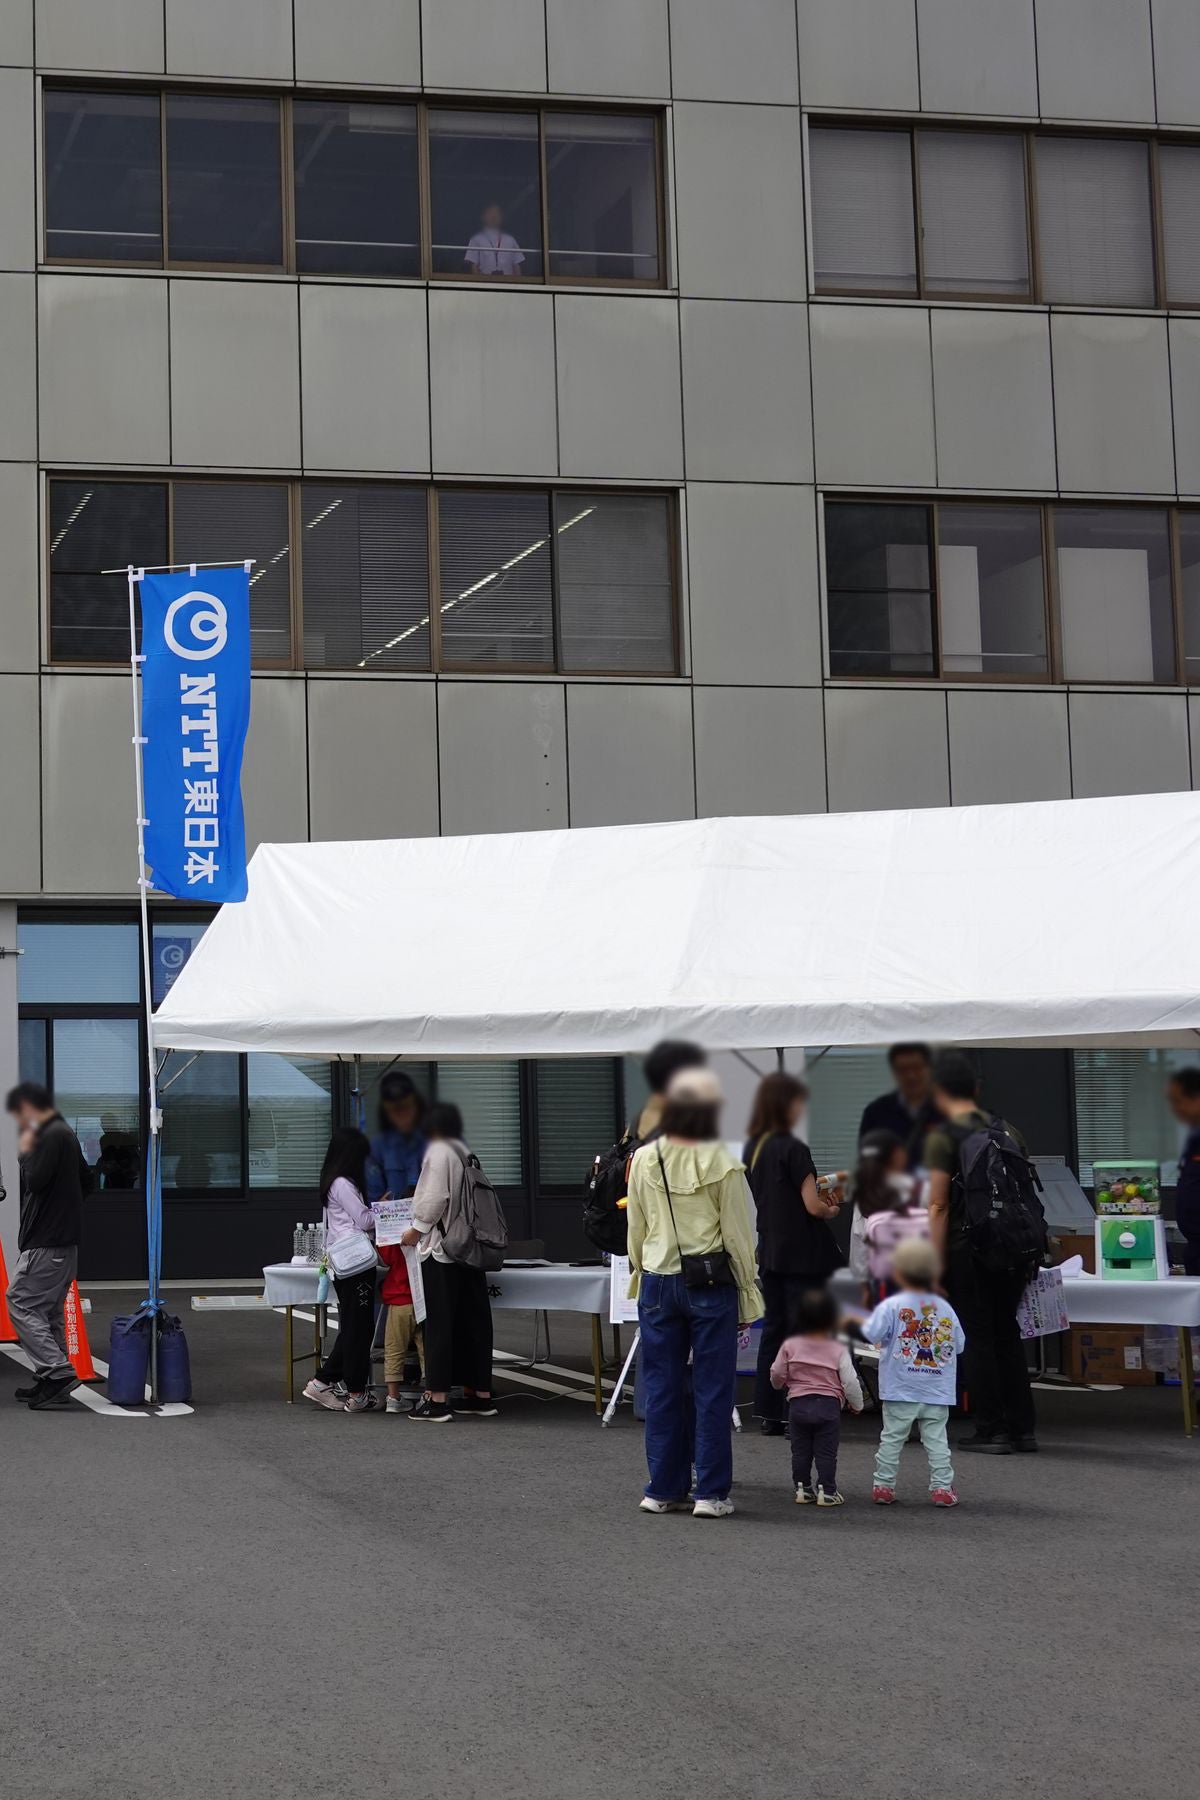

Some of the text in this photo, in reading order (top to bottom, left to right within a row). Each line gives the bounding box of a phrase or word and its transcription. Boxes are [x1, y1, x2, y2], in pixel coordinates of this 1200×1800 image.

[179, 672, 220, 885] NTT東日本
[921, 1367, 943, 1376] PATROL
